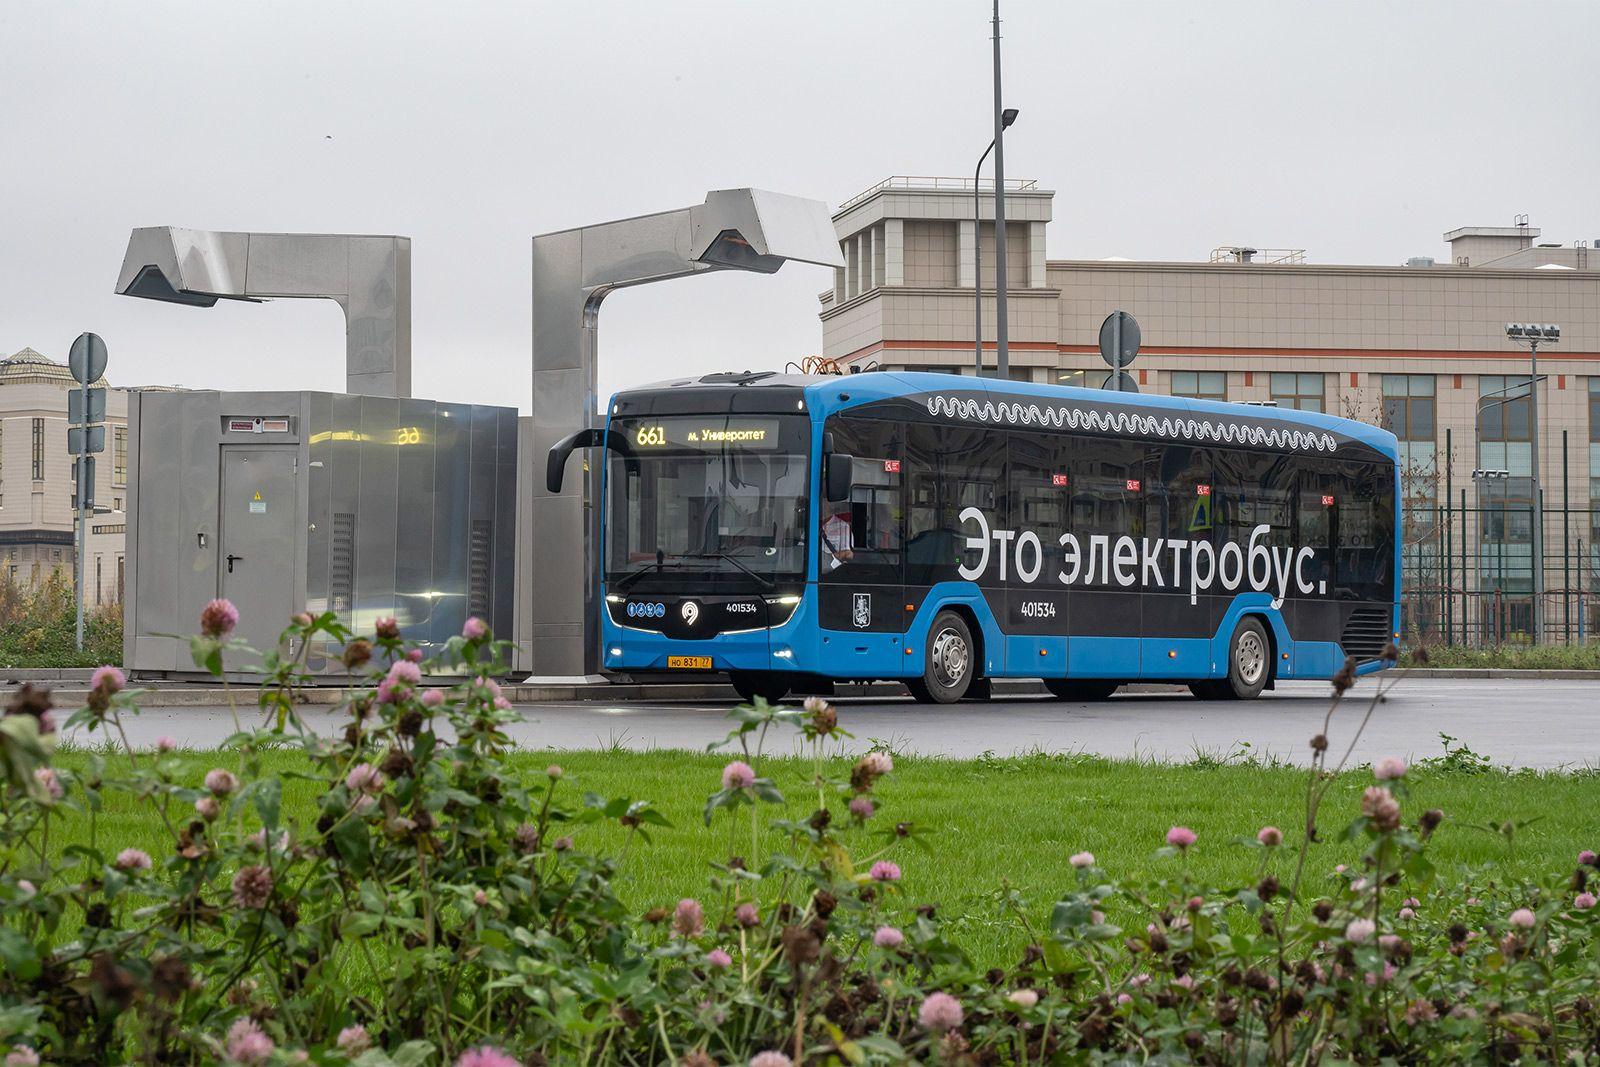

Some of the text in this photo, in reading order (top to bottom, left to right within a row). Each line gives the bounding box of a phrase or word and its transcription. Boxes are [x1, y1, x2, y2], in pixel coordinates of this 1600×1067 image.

[637, 426, 666, 446] 661
[687, 429, 766, 442] м. Университет
[957, 506, 1327, 610] Это электробус.
[726, 603, 758, 613] 401534
[1021, 601, 1056, 618] 401534
[683, 657, 698, 667] 831
